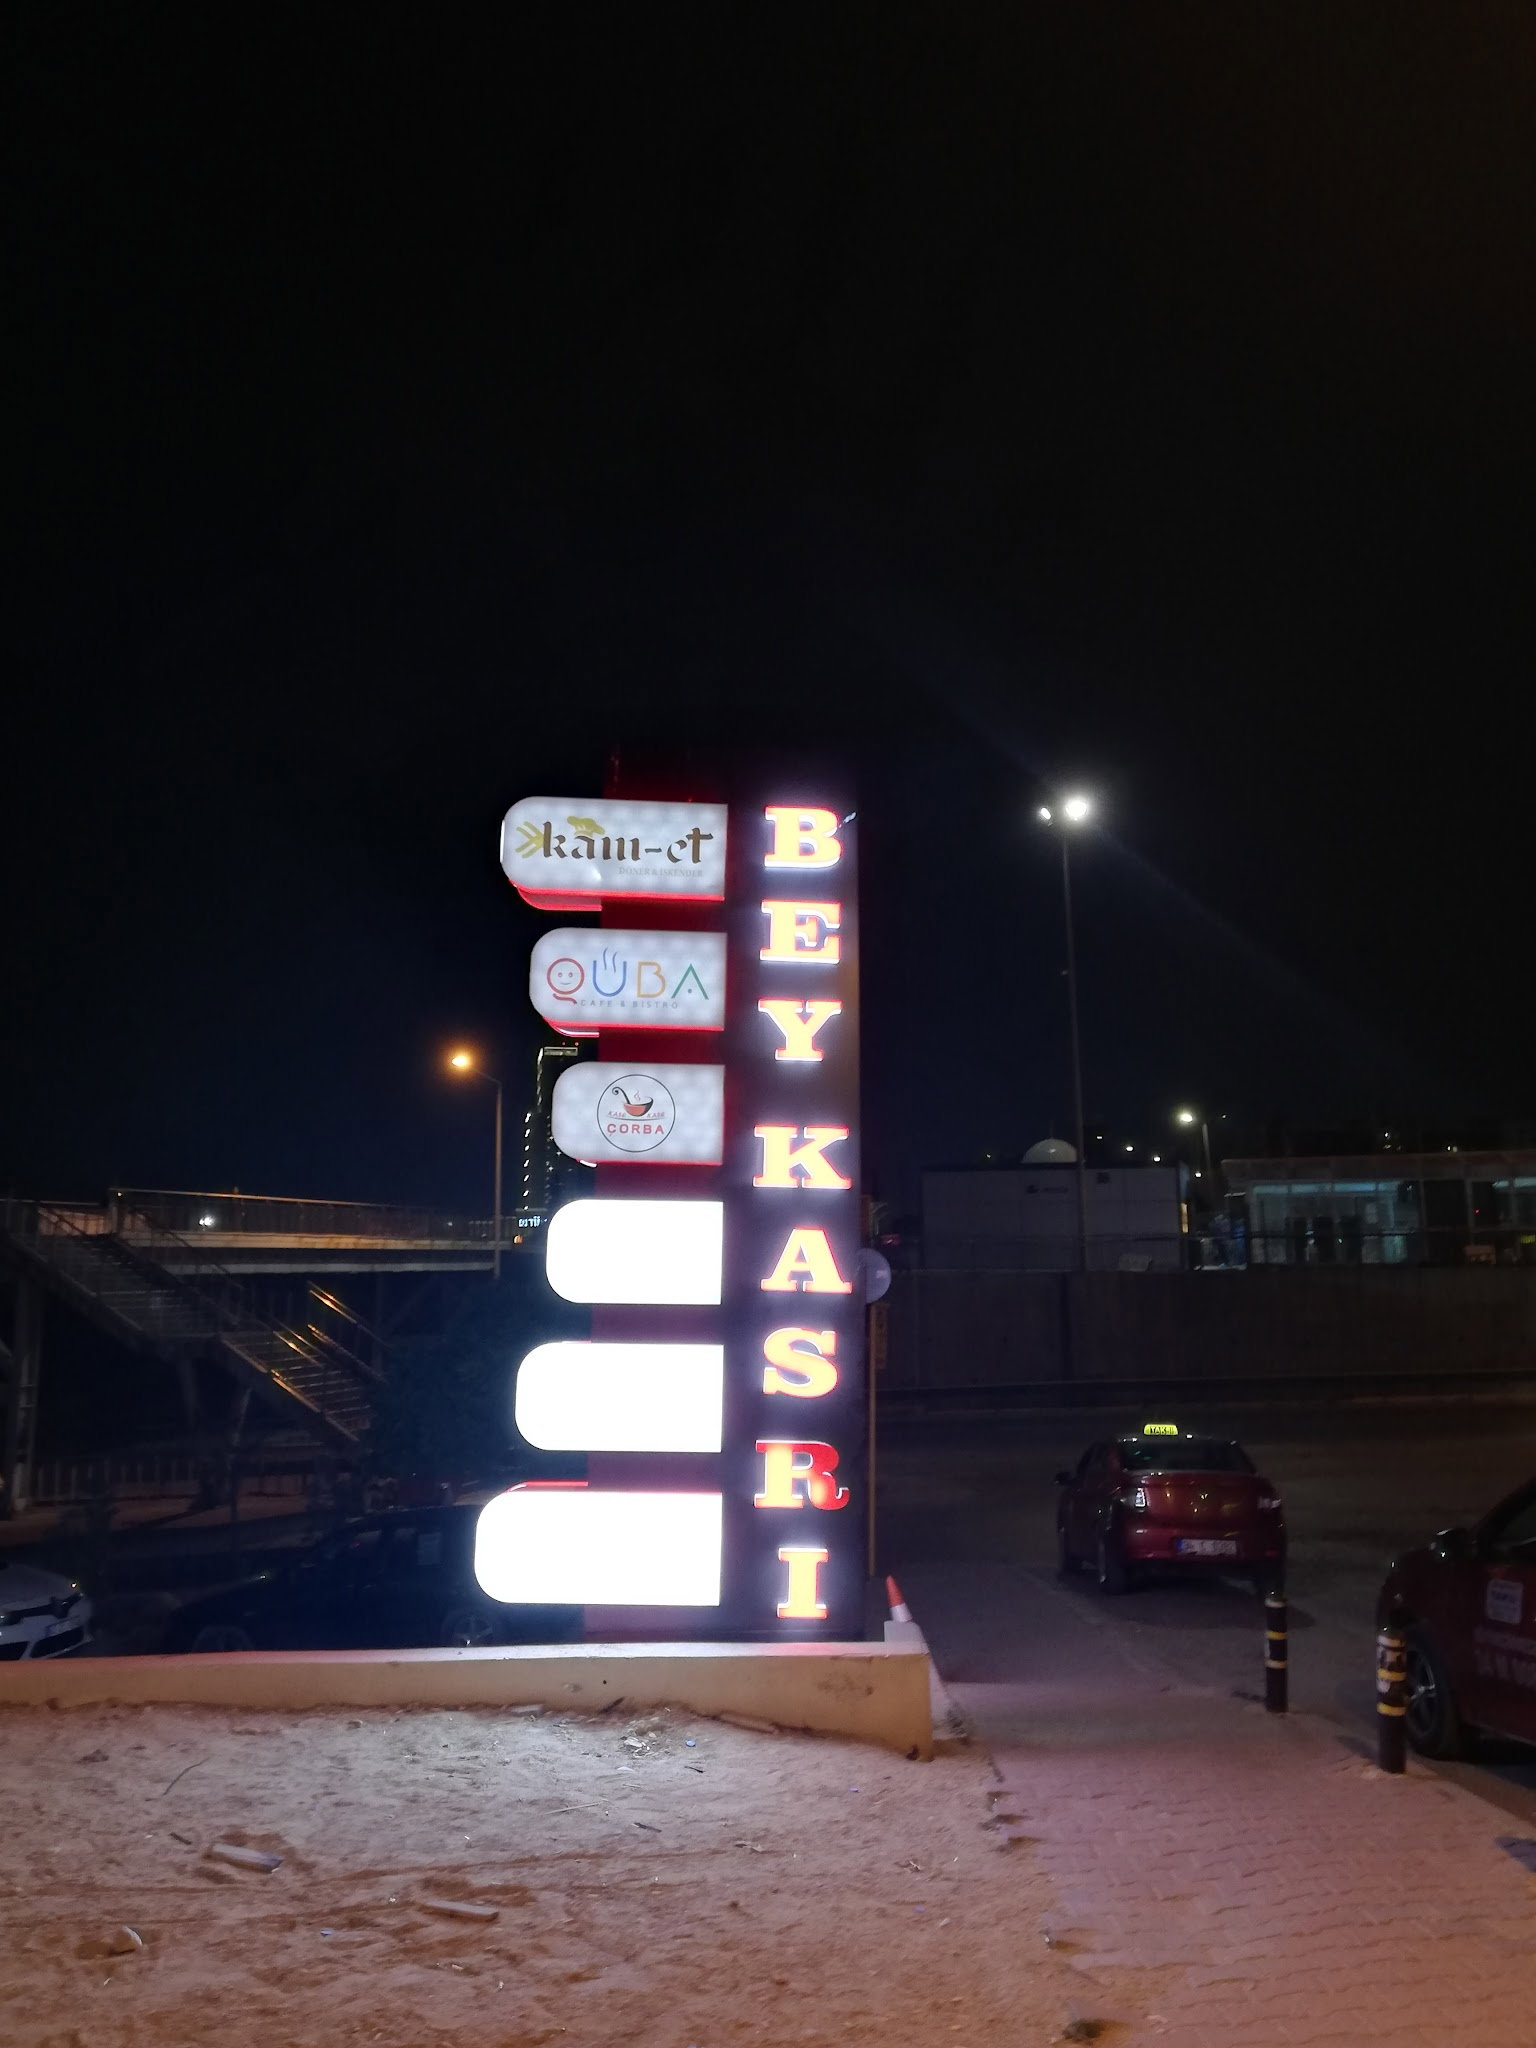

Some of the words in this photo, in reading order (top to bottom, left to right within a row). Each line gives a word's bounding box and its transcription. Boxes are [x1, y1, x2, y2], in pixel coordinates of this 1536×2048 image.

[543, 821, 714, 864] kam-et
[546, 957, 710, 1005] QUBA
[620, 1000, 626, 1008] &
